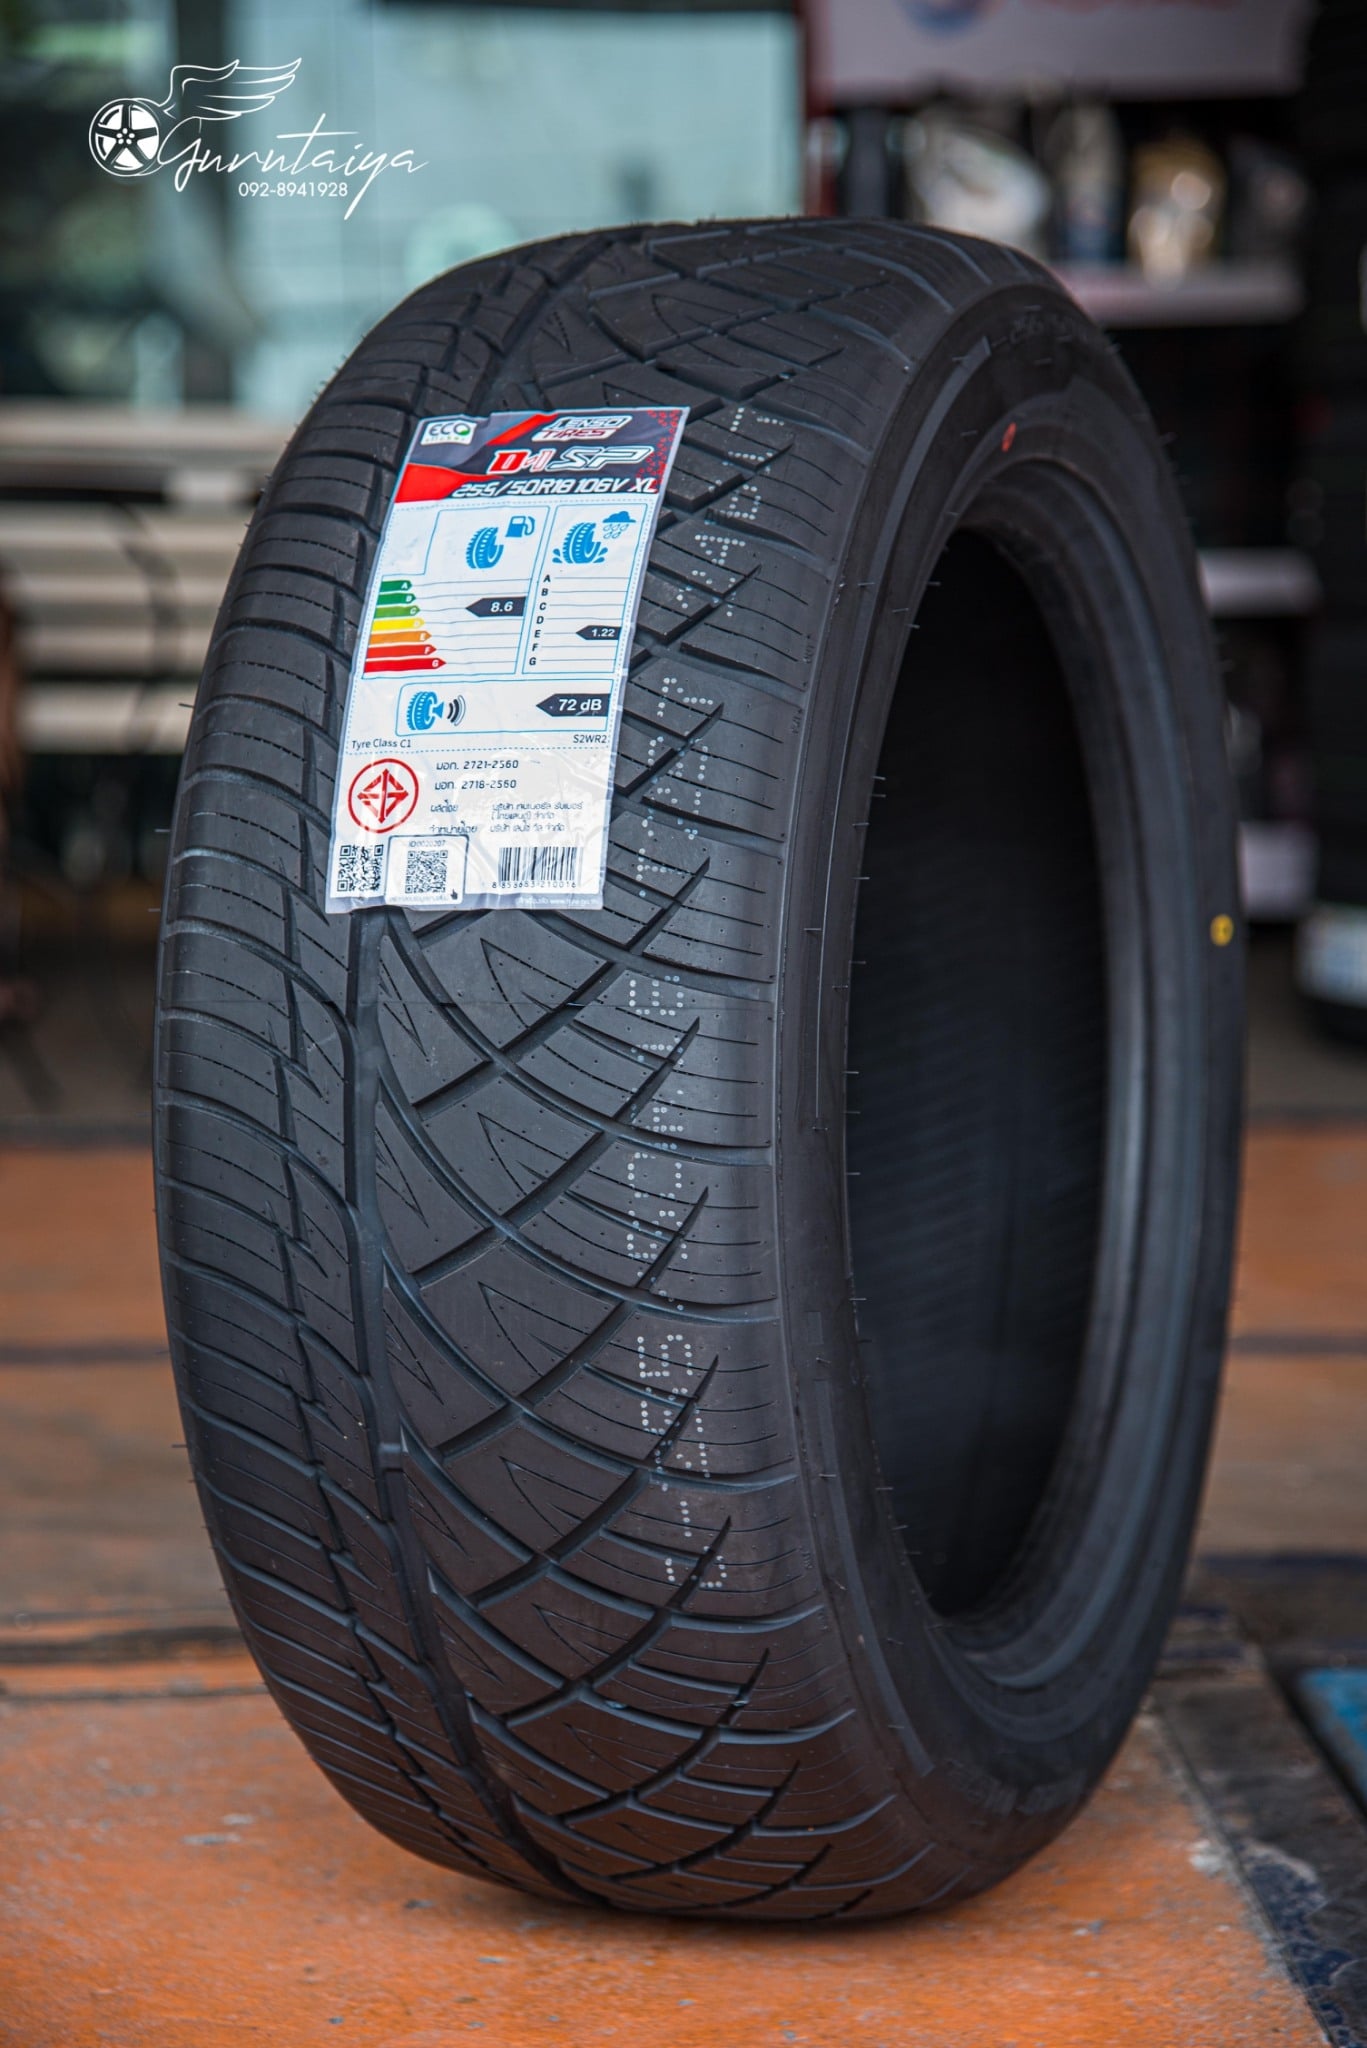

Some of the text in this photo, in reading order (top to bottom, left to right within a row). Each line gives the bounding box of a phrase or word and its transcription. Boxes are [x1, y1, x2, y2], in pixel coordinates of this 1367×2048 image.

[543, 416, 629, 430] LENSO
[428, 422, 471, 436] ECO
[542, 428, 606, 439] TIRES
[452, 477, 659, 498] 255/50R18 106V XL
[541, 588, 548, 596] B
[490, 601, 513, 612] 8.6
[540, 602, 547, 610] C
[536, 616, 544, 624] D
[534, 630, 541, 638] E
[591, 628, 615, 637] 1.22
[532, 643, 539, 651] F
[529, 657, 536, 666] G
[558, 698, 602, 711] 72 dB
[573, 734, 607, 744] S2WR2
[352, 738, 411, 751] Tyre Class C1
[463, 760, 519, 770] 2721-2560
[461, 779, 517, 790] 2718-2560
